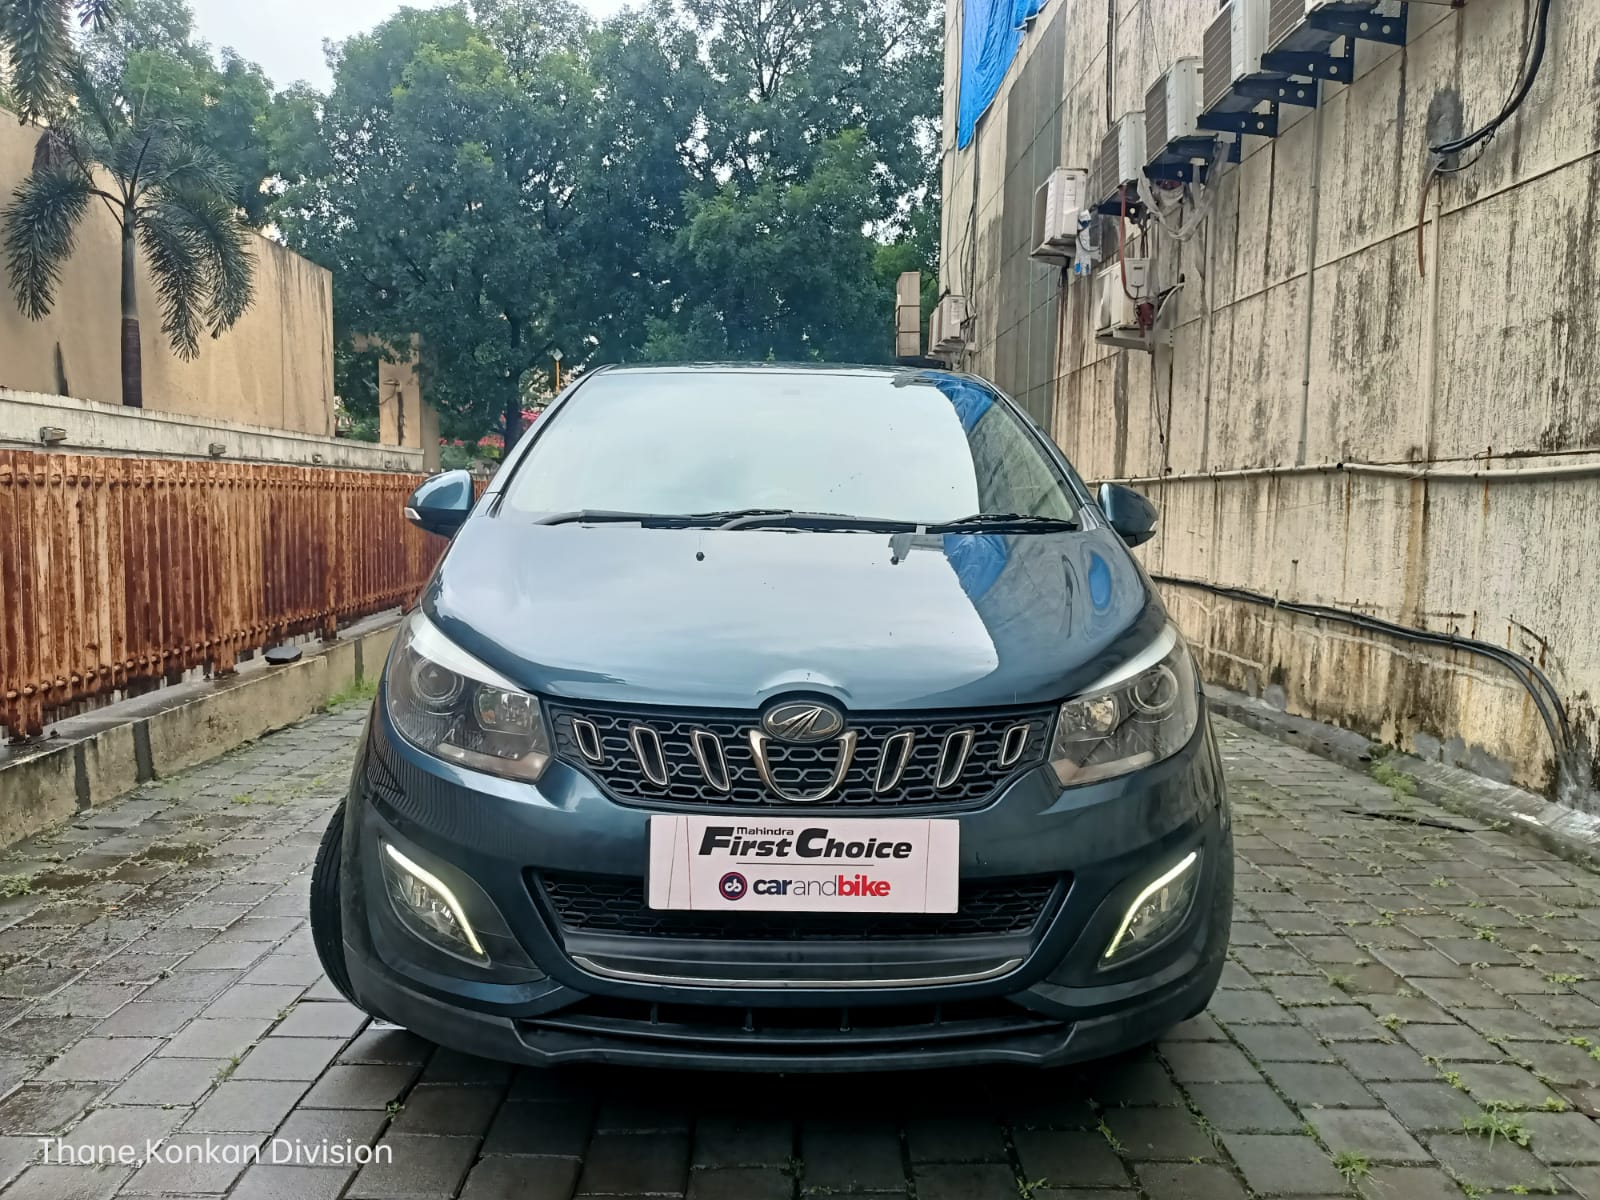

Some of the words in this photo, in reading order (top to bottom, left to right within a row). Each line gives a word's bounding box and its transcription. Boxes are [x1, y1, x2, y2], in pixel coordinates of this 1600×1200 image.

[698, 826, 792, 857] First
[795, 828, 913, 859] Choice
[736, 827, 794, 836] Mahindra
[753, 874, 891, 897] carandbike
